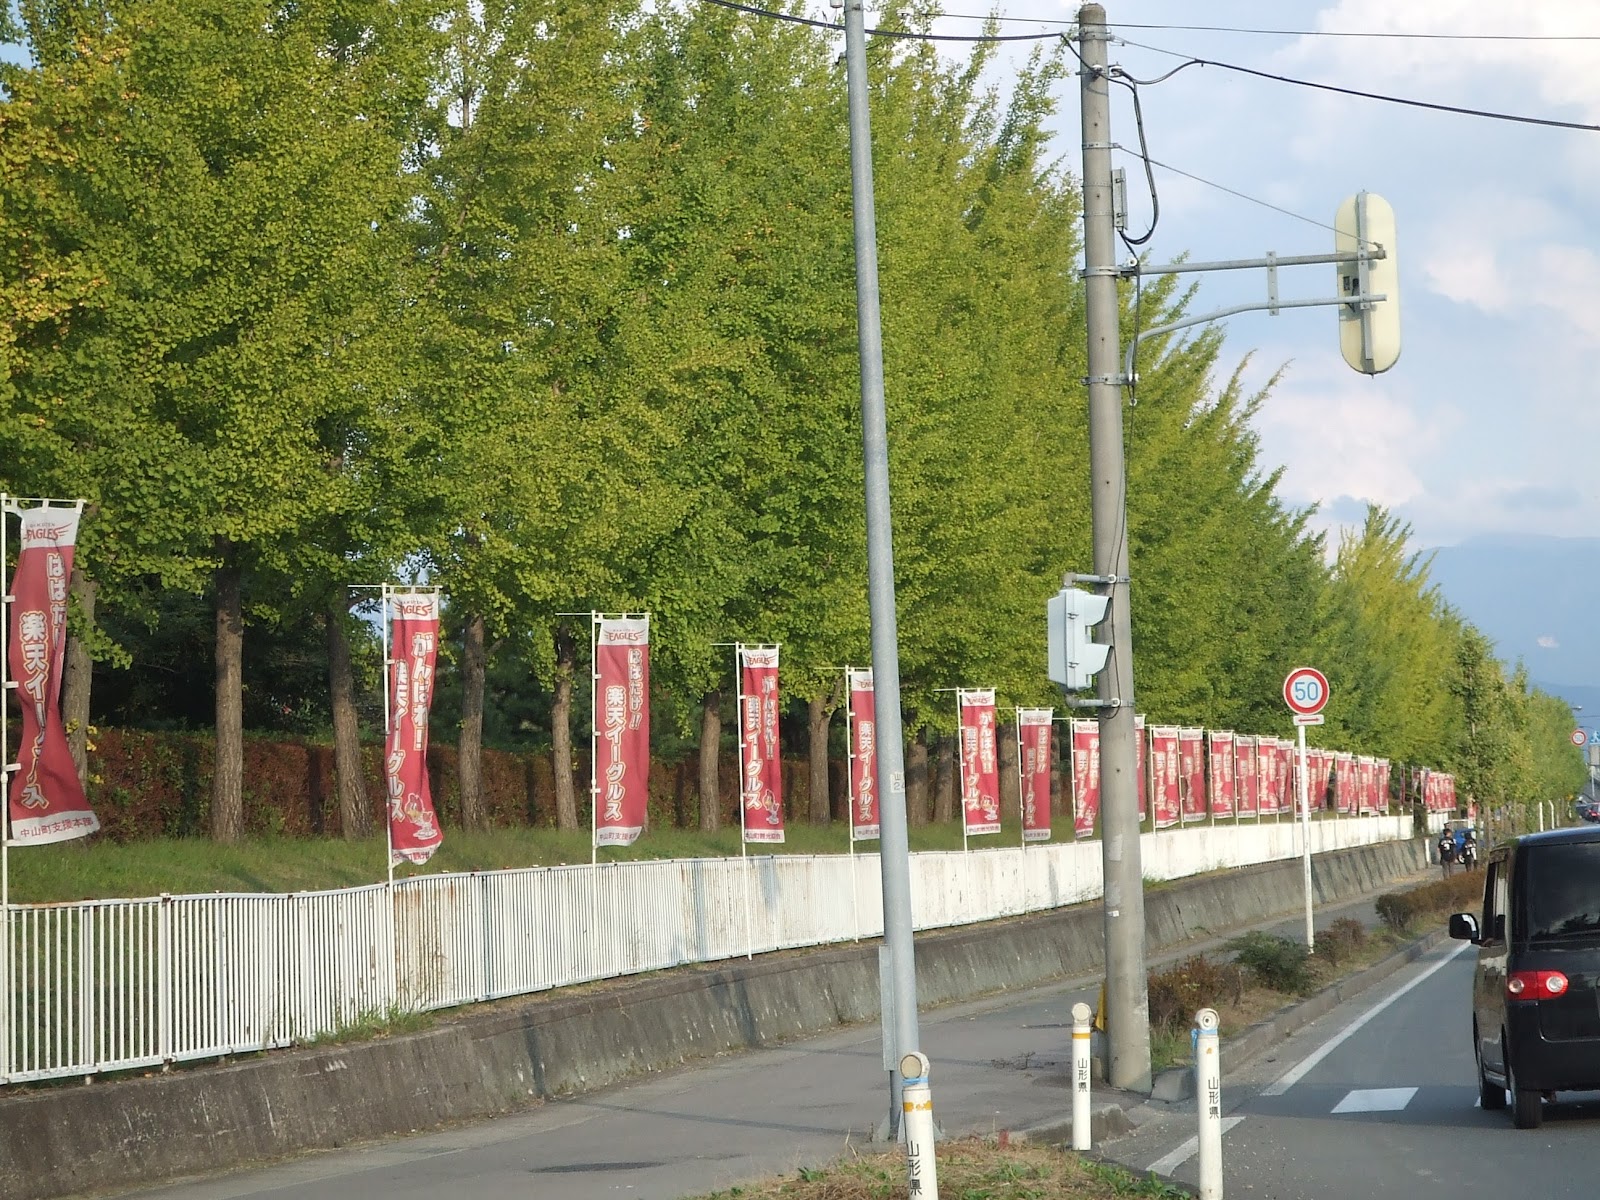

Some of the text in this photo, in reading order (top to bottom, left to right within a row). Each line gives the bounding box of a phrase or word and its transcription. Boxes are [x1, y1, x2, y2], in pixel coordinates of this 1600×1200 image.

[399, 605, 429, 616] AGLES
[609, 632, 639, 641] EAGLES
[1294, 681, 1319, 701] 50
[605, 685, 627, 821] 楽天イーグルス
[746, 695, 763, 810] 楽天イーグルス
[859, 720, 874, 822] 楽天イーグルス
[966, 726, 980, 811] 楽天イーグルス
[1077, 1057, 1088, 1093] 山形県
[1208, 1076, 1219, 1120] 山形県
[906, 1140, 922, 1196] 山形県
